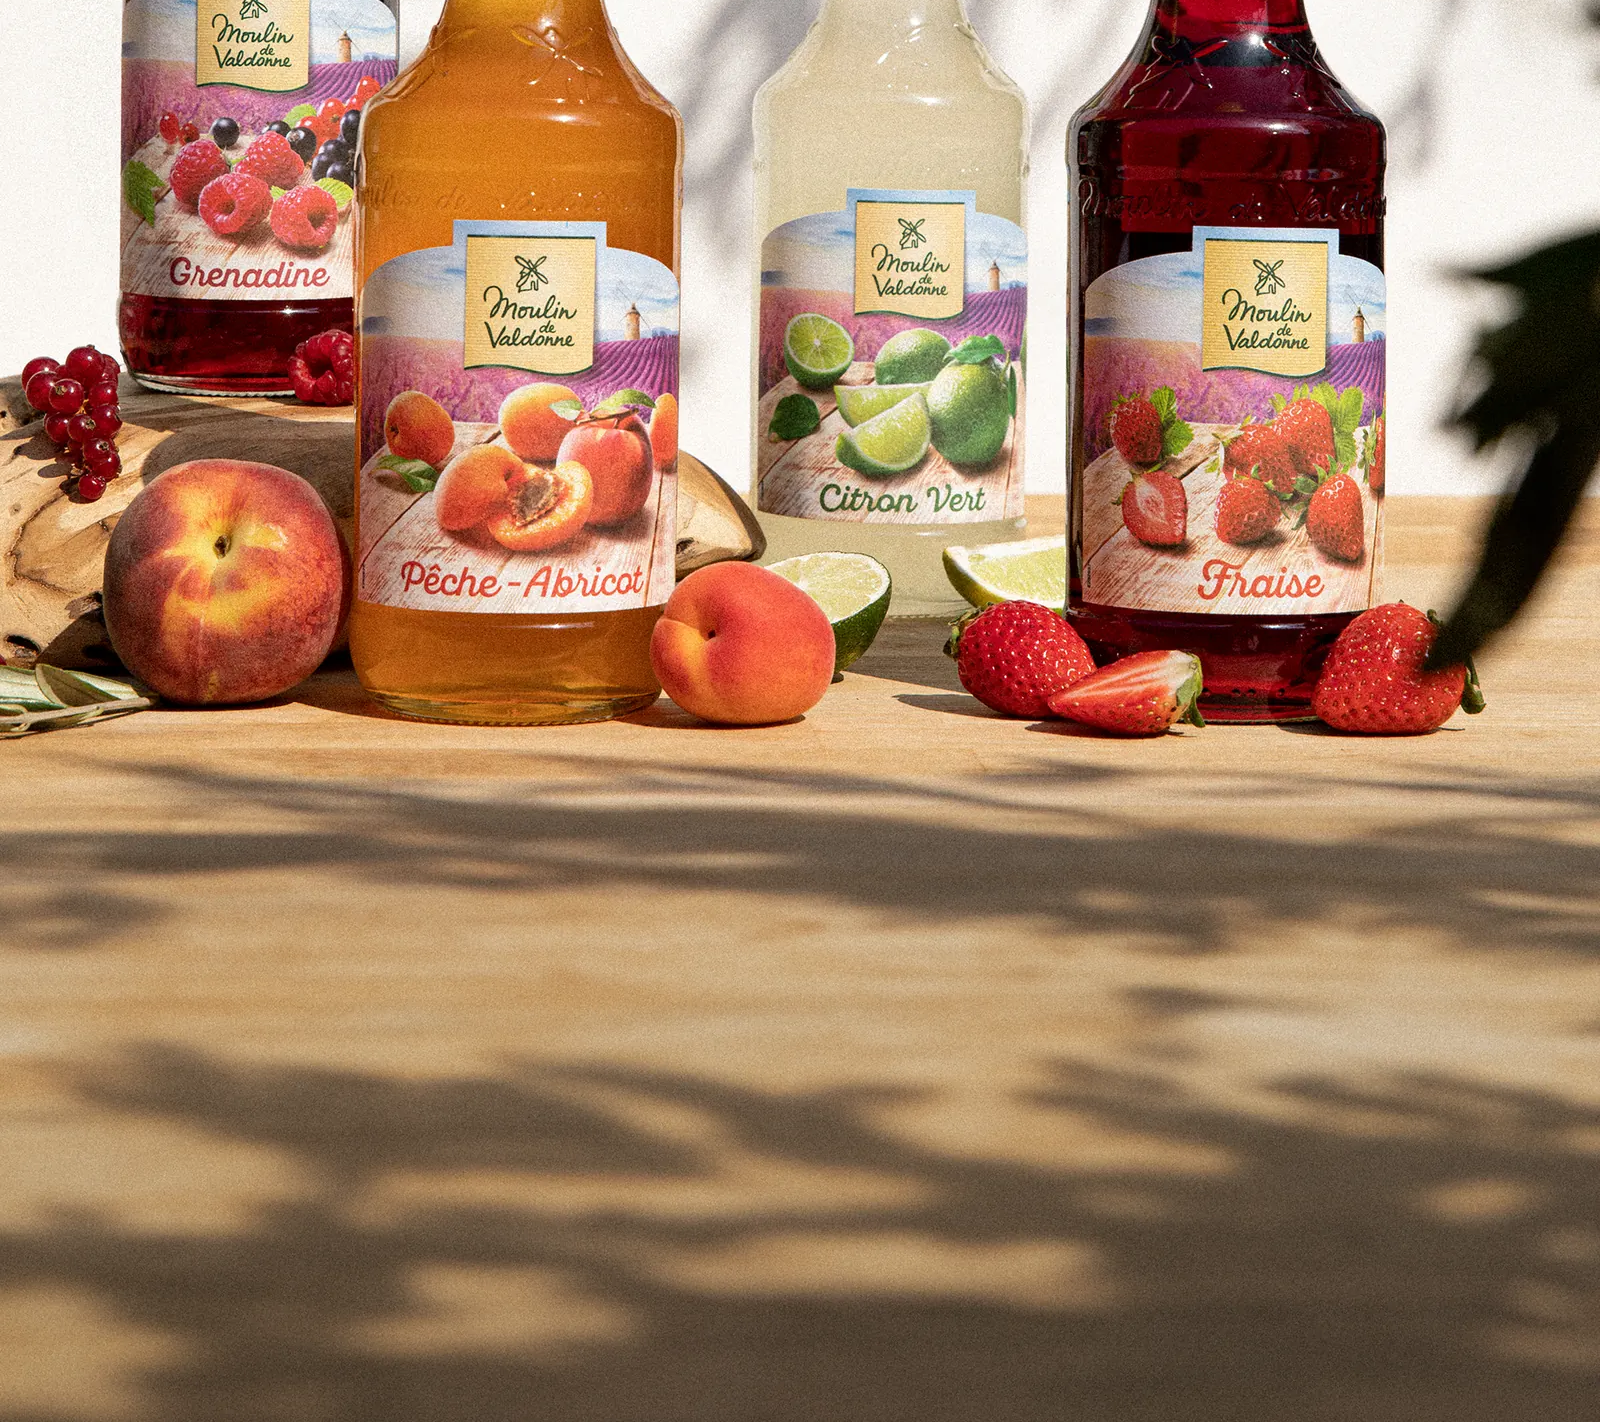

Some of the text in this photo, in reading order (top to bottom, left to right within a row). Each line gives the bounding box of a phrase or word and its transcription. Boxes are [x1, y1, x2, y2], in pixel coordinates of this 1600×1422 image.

[212, 13, 294, 43] Moulin
[212, 44, 293, 69] Valdonne
[260, 44, 275, 56] de
[871, 243, 950, 273] Moulin
[169, 256, 331, 288] Grenadine
[872, 274, 949, 297] Valdonne
[919, 273, 933, 285] de
[483, 285, 577, 319] Moulin
[1222, 288, 1312, 322] Moulin
[484, 321, 575, 348] Valdonne
[540, 320, 556, 333] de
[1223, 324, 1310, 350] Valdonne
[1277, 323, 1292, 336] de
[819, 483, 986, 513] Citron Vert
[1198, 558, 1325, 600] Fraise
